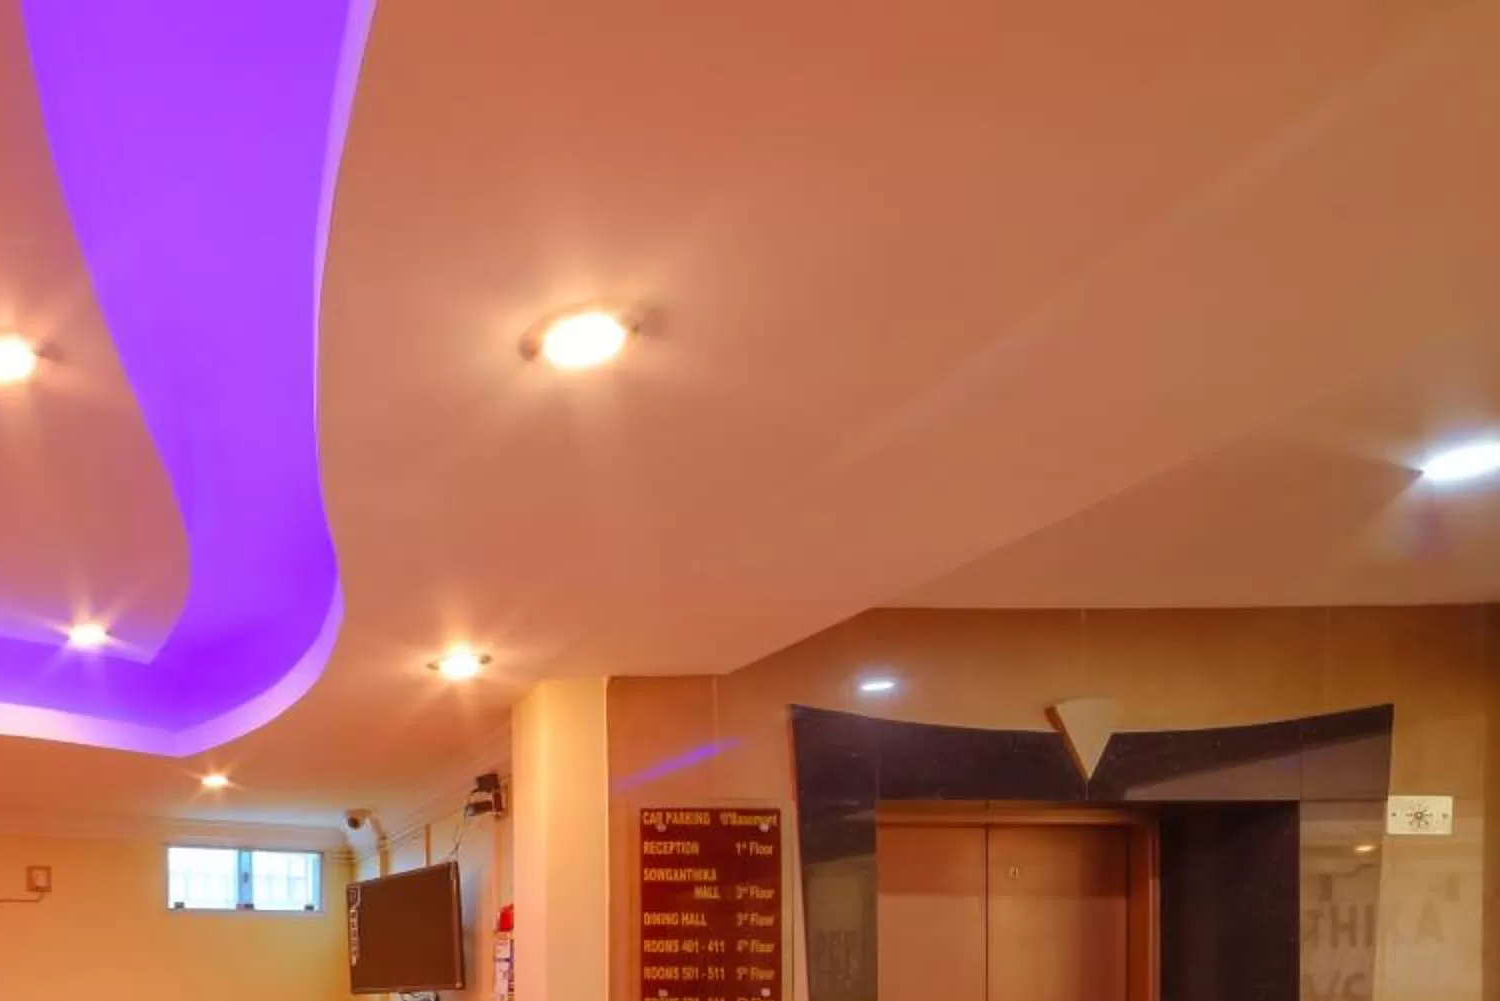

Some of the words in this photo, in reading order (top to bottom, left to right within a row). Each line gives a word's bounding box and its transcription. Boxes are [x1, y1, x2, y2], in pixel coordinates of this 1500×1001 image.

[666, 811, 711, 825] PARKING
[643, 841, 700, 856] RECEPTION
[749, 841, 774, 856] Floor
[693, 885, 721, 899] HALL
[750, 886, 775, 899] Floor
[643, 912, 678, 925] DINING
[681, 912, 708, 926] HALL
[750, 912, 775, 927] Floor
[643, 939, 680, 953] ROOMS
[643, 966, 680, 980] ROOMS
